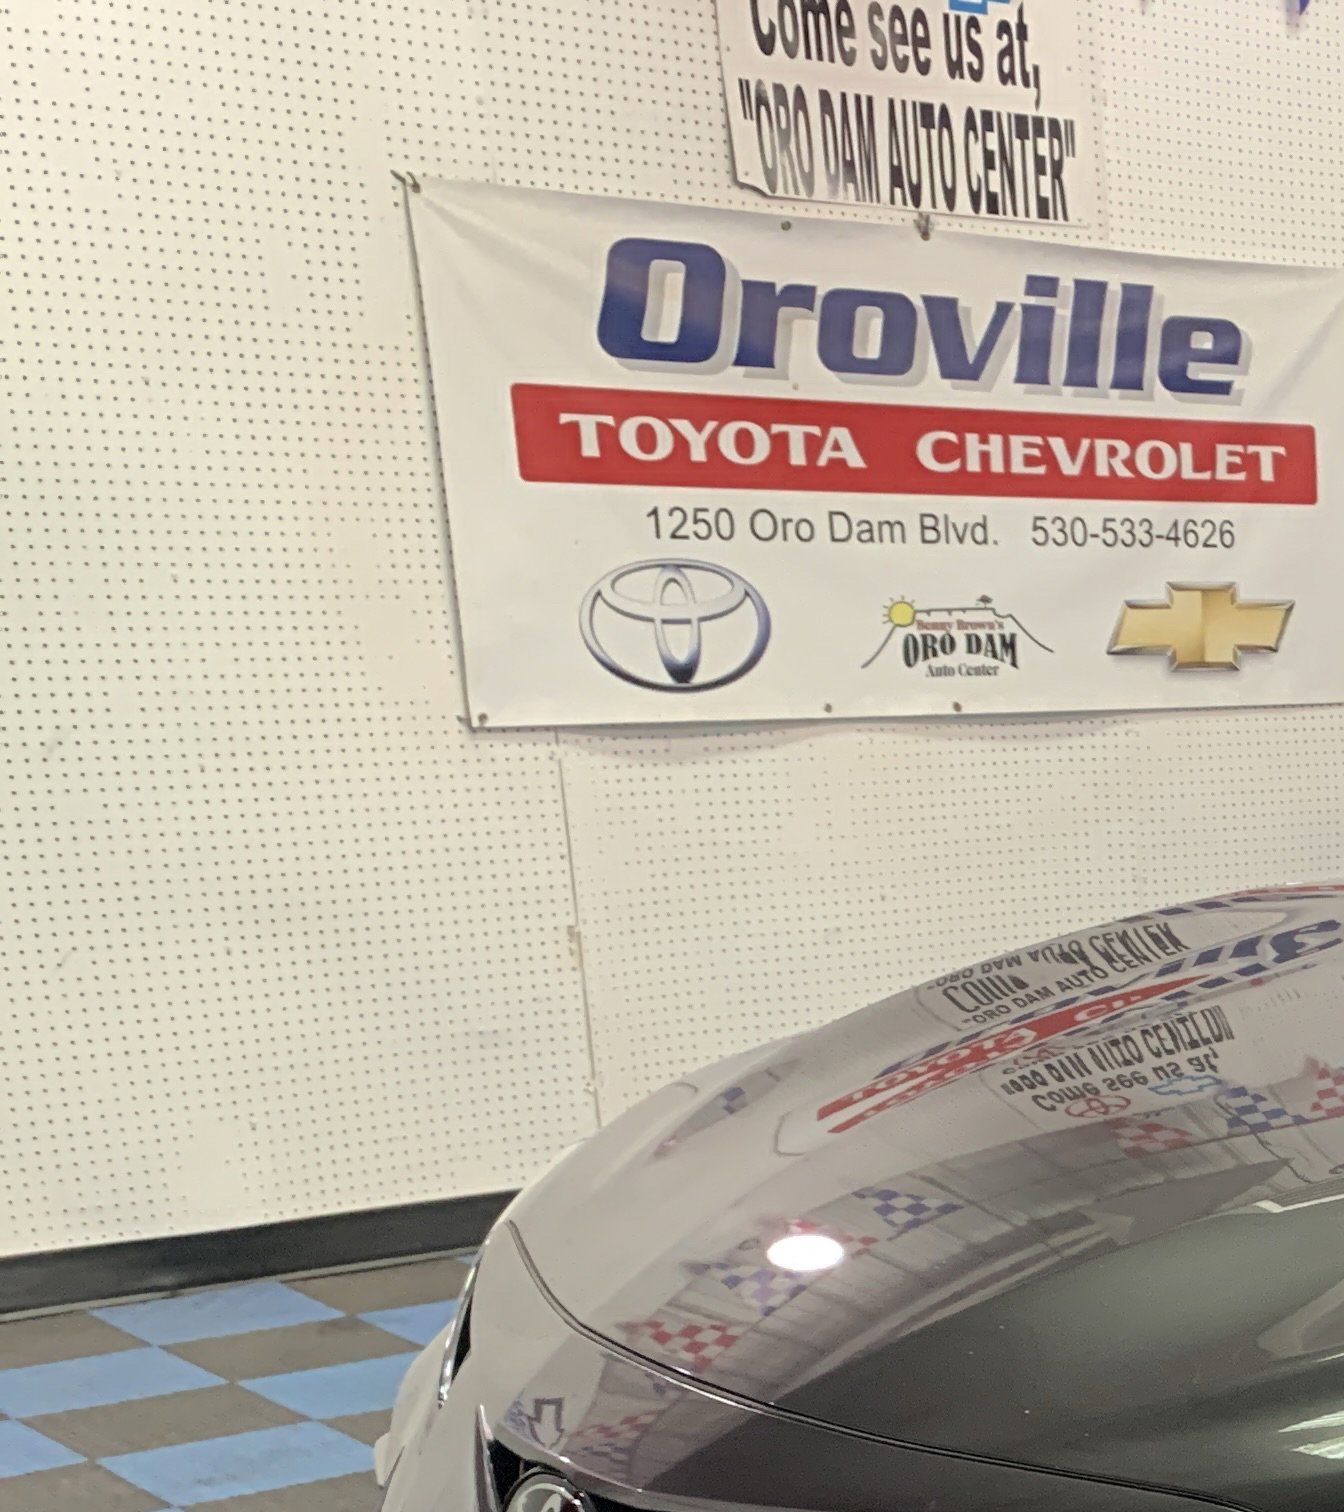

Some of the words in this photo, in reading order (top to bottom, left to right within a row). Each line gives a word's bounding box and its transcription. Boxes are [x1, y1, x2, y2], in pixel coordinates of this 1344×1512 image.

[750, 0, 857, 67] Come
[868, 2, 932, 76] see
[942, 12, 985, 83] us
[996, 3, 1042, 111] at,
[738, 78, 815, 198] "ORO
[818, 88, 882, 203] DAM
[888, 97, 957, 212] AUTO
[963, 106, 1076, 222] CENTER"
[596, 237, 1246, 398] Oroville
[558, 411, 868, 469] TOYOTA
[915, 430, 1288, 483] CHEVROLET
[645, 506, 736, 541] 1250
[749, 508, 815, 543] Oro
[828, 510, 907, 545] Dam
[918, 512, 1000, 547] Blvd.
[1031, 515, 1236, 549] 530-533-4626
[902, 632, 957, 669] ORO
[964, 632, 1020, 670] DAM
[925, 664, 956, 678] Auto
[958, 663, 1000, 677] Center
